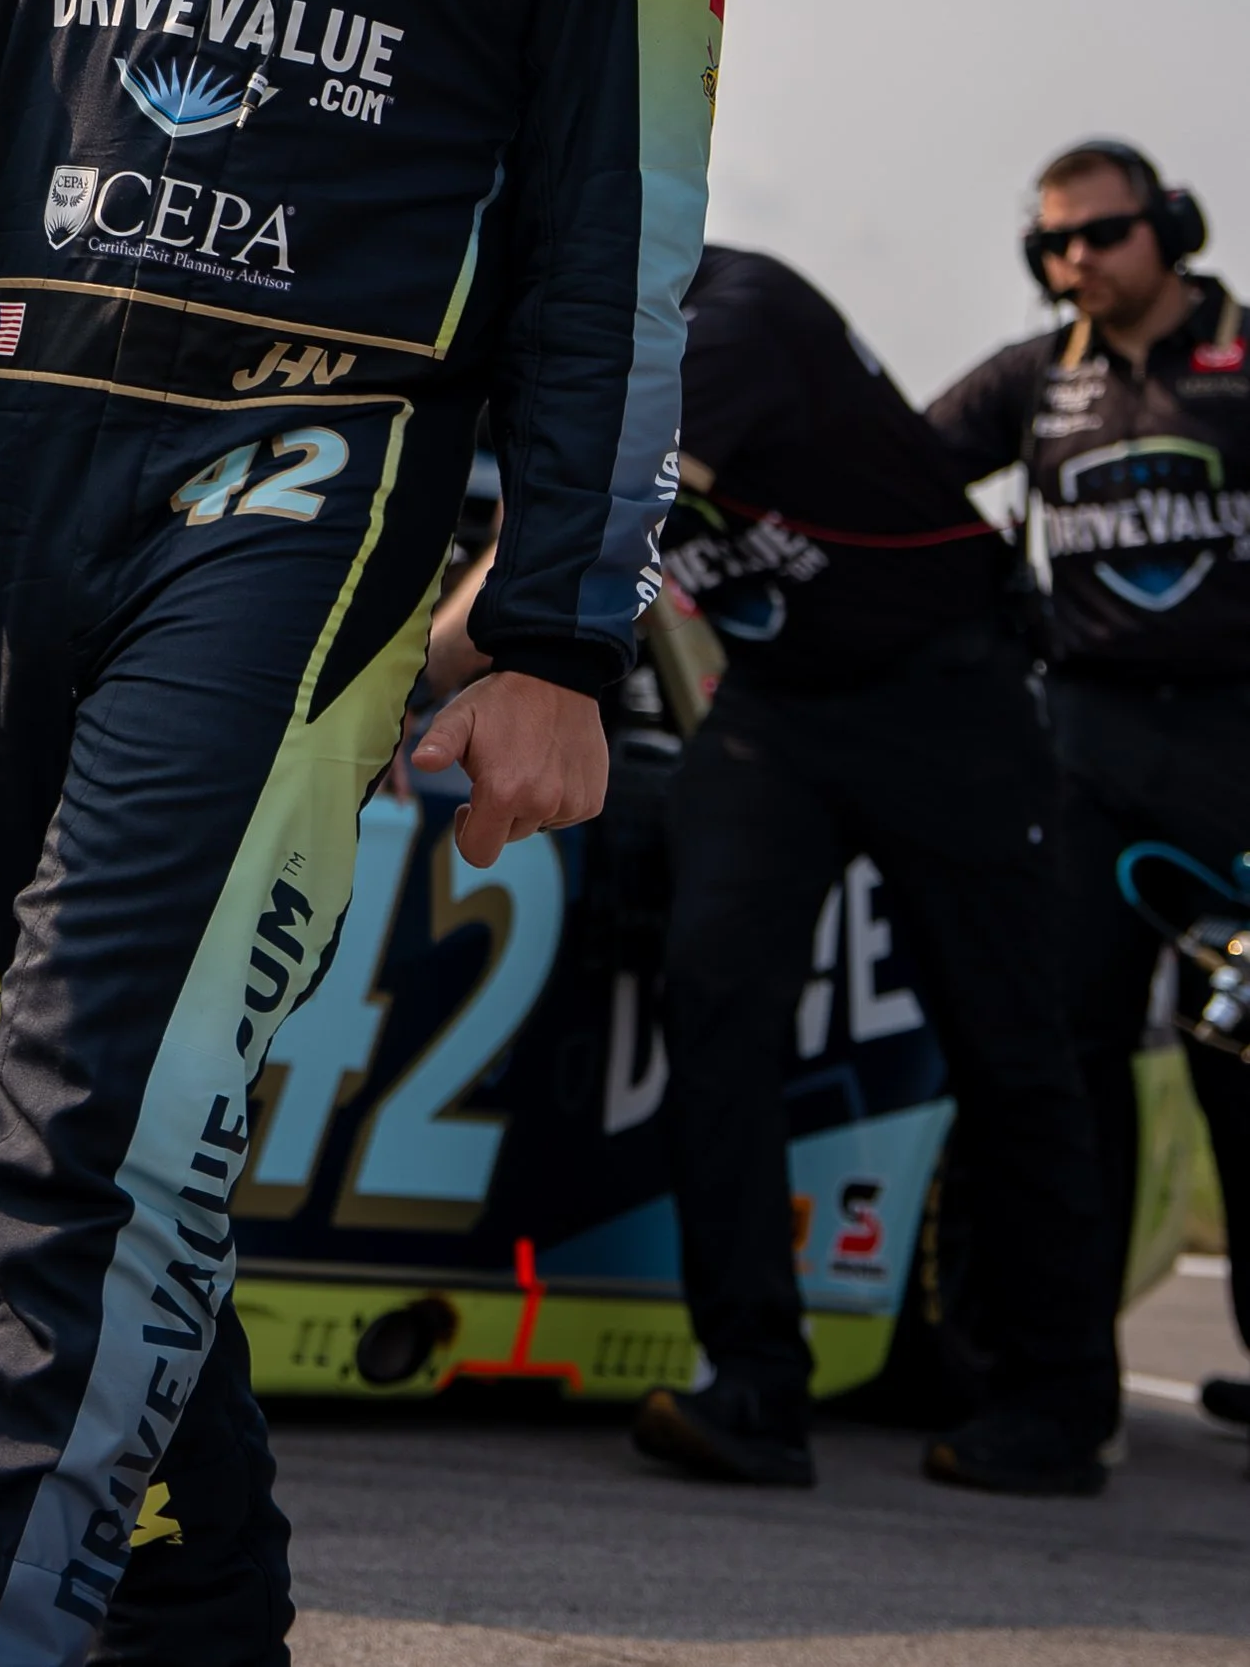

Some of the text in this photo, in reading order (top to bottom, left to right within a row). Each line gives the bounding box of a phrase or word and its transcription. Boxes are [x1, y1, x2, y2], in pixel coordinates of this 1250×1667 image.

[309, 78, 386, 125] .COM
[56, 174, 85, 189] CEPA
[94, 171, 295, 274] CEPA
[88, 237, 291, 292] Certified Exit Planning Advisor
[170, 425, 350, 526] 42
